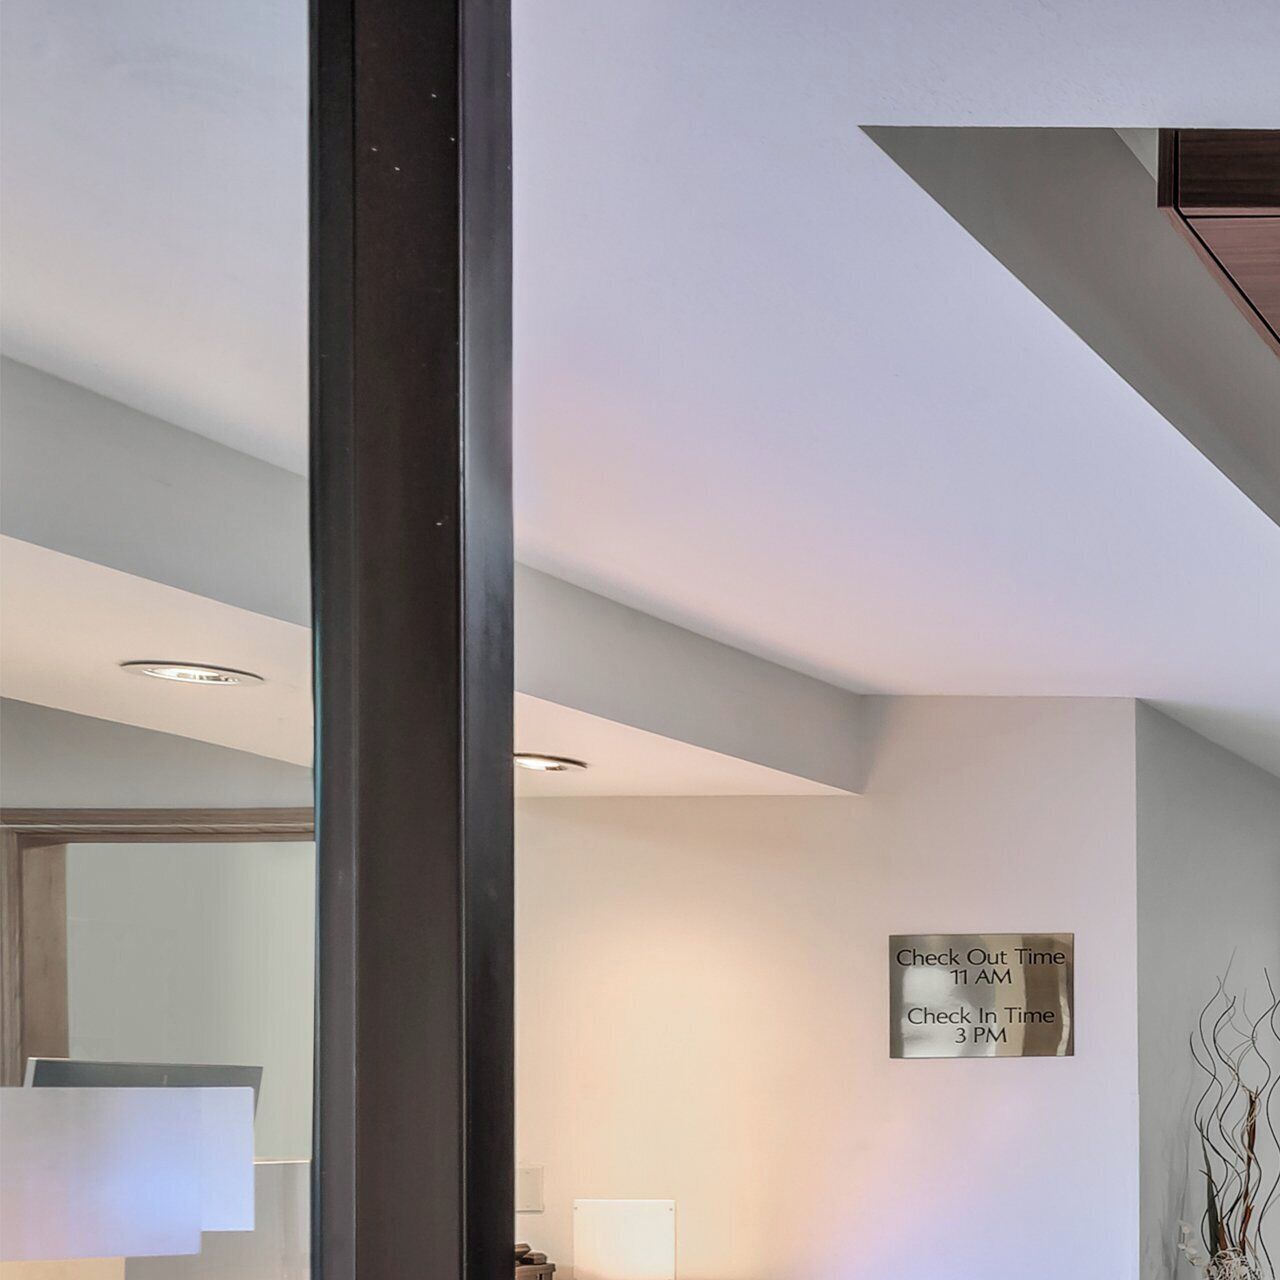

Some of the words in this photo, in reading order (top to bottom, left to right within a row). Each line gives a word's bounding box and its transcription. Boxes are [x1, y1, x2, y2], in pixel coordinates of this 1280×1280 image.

[896, 948, 961, 966] Check
[966, 948, 1008, 966] Out
[1014, 948, 1066, 965] Time
[950, 969, 968, 985] 11
[974, 968, 1012, 985] AM
[907, 1006, 972, 1025] Check
[979, 1007, 997, 1024] In
[1004, 1006, 1055, 1024] Time
[954, 1027, 967, 1044] 3
[974, 1027, 1008, 1043] PM
